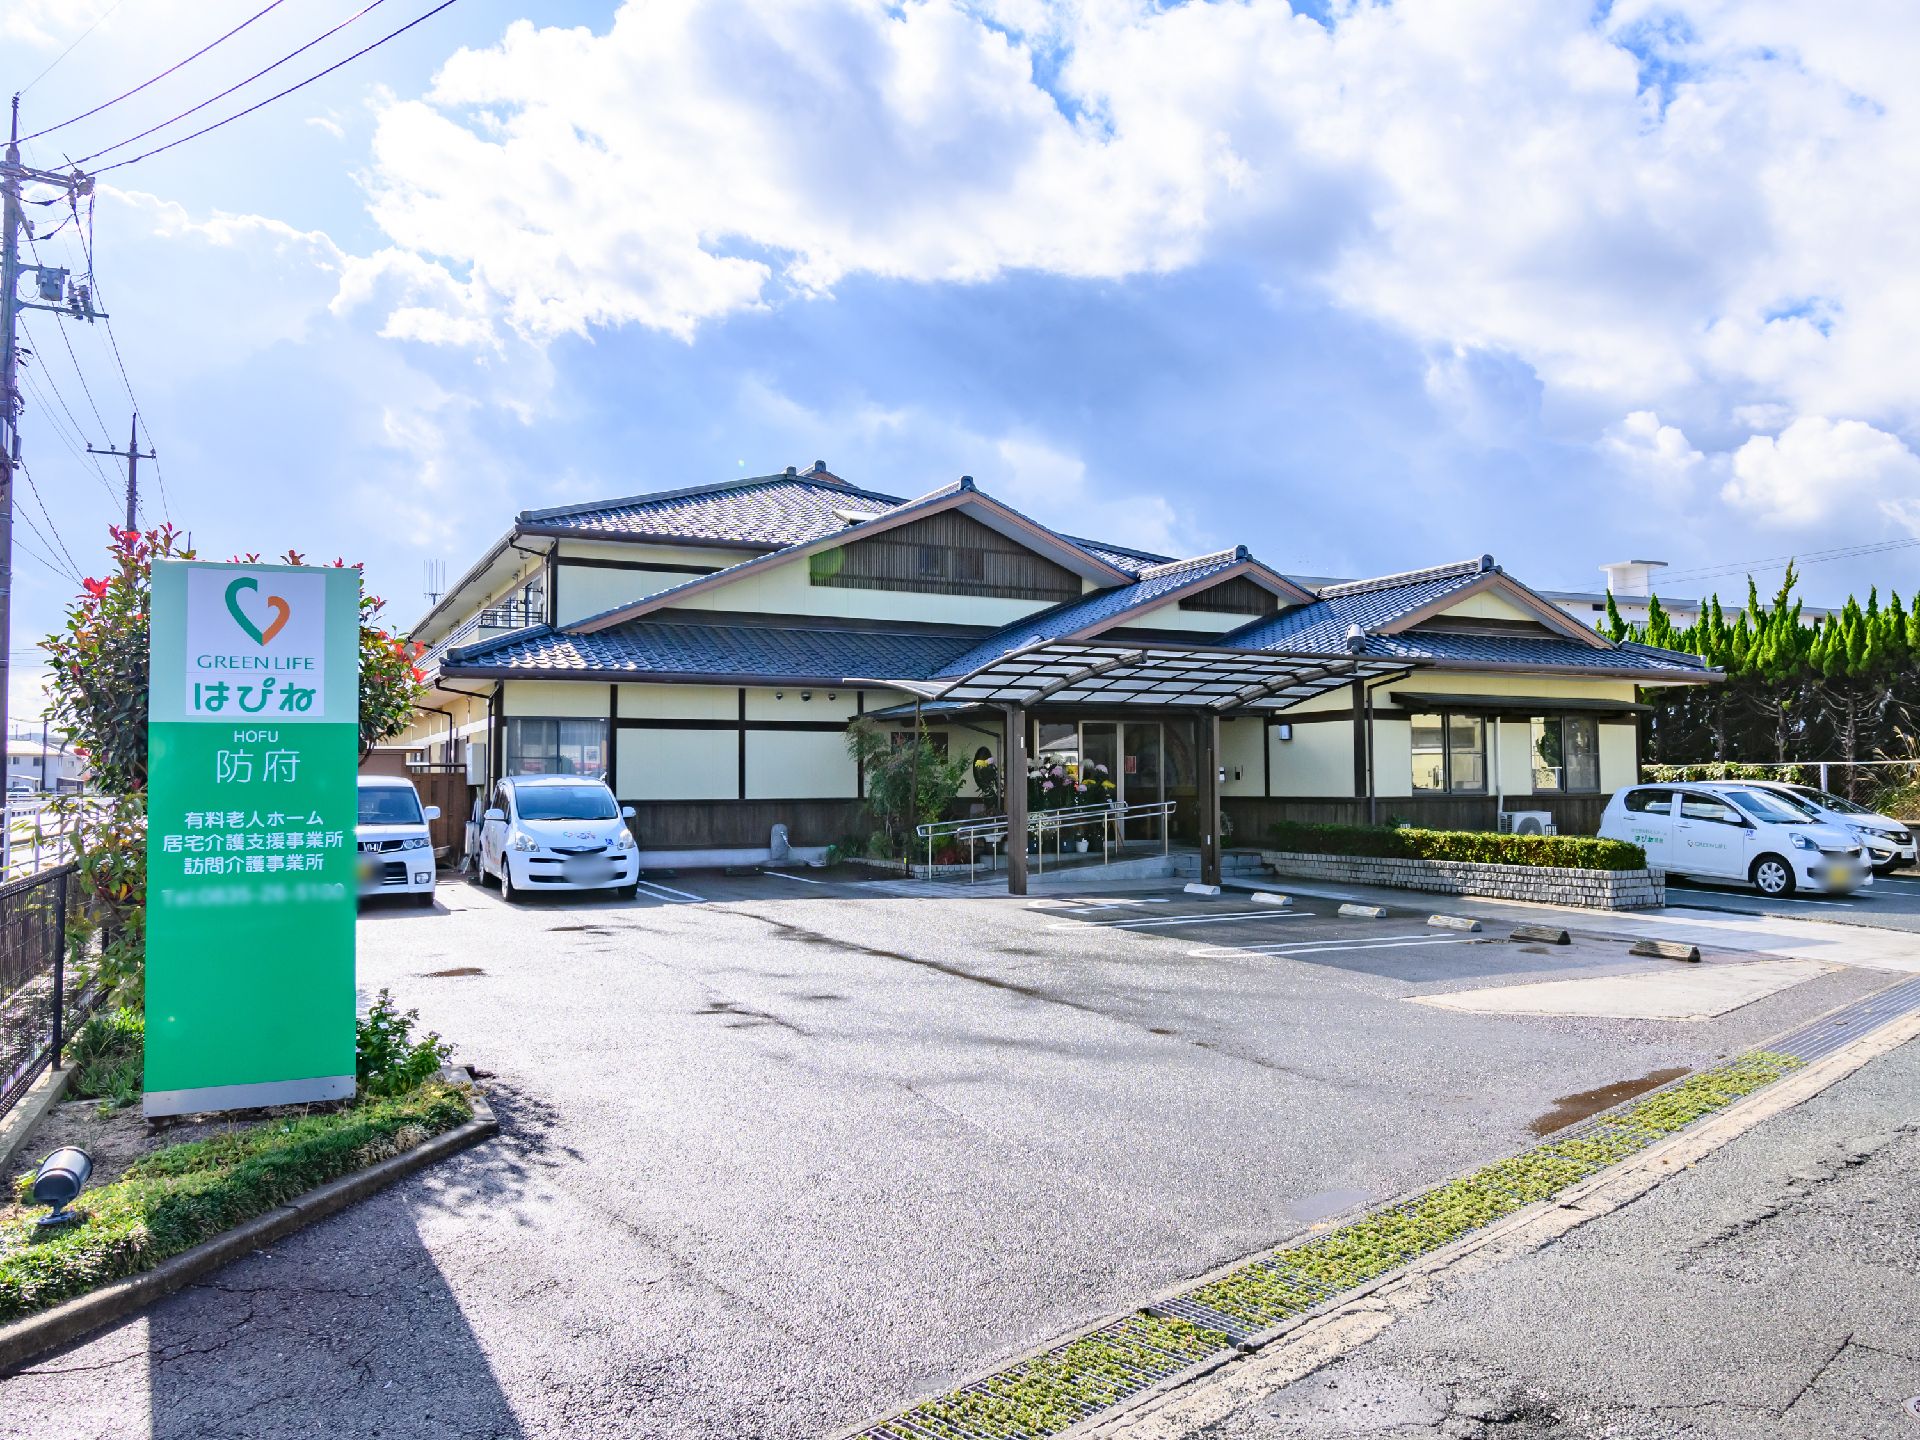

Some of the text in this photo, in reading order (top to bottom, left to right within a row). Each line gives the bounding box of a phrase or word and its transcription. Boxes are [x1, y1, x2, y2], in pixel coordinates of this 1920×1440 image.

[197, 655, 315, 670] GREEN LIFE
[194, 677, 316, 712] はぴね
[233, 730, 279, 743] HOFU
[216, 748, 300, 783] 防府
[184, 810, 324, 829] 有料老人ホーム
[163, 830, 344, 853] 居宅介護支援事業所
[183, 853, 324, 875] 訪問介護事業所
